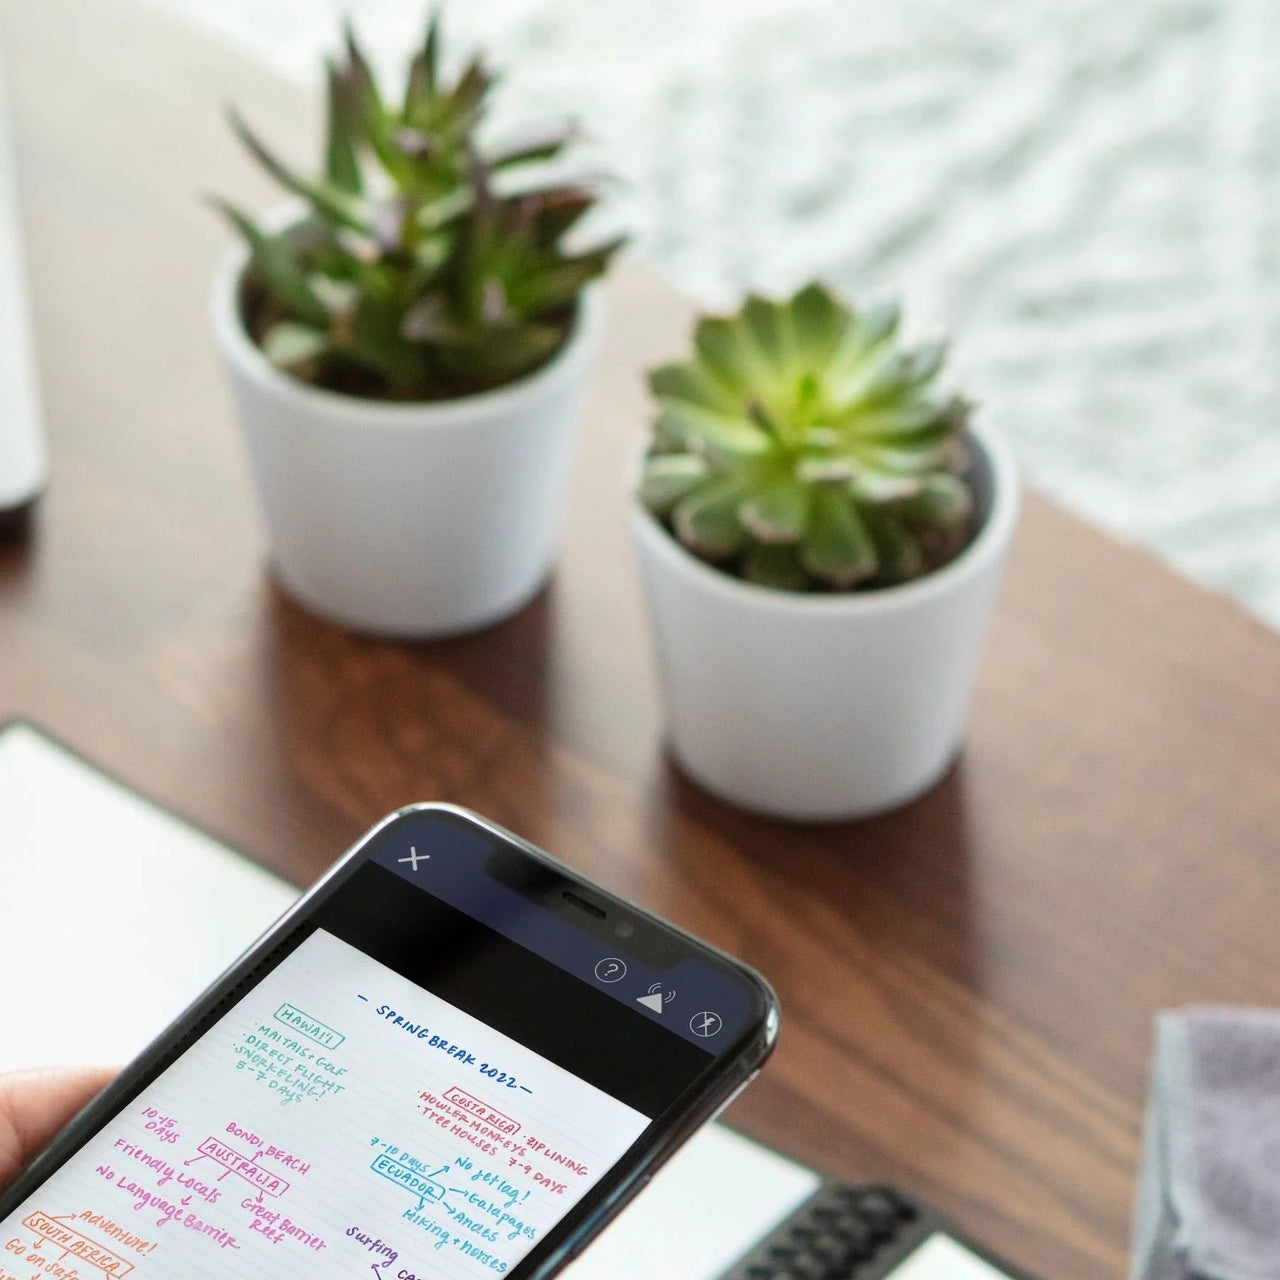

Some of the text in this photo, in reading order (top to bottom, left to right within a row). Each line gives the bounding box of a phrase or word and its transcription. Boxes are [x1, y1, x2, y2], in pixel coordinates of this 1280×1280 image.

[246, 1035, 345, 1095] DIRECT FLIGHT
[376, 1004, 517, 1088] SPRING BREAK 2022
[451, 1093, 515, 1134] COSTA RICA
[113, 1138, 173, 1187] Friendly
[205, 1142, 280, 1192] AUSTRALIA
[226, 1122, 311, 1176] BONDI BEACH
[454, 1156, 472, 1171] No
[95, 1165, 115, 1181] No
[116, 1176, 184, 1227] Language
[378, 1160, 437, 1200] ECUADOR
[532, 1172, 568, 1195] DAYS
[78, 1210, 158, 1256] Adventure!
[240, 1198, 327, 1253] Great Barrier
[248, 1219, 287, 1245] Reef
[453, 1211, 500, 1243] Andes
[468, 1193, 538, 1242] Galapagos
[4, 1238, 27, 1255] Go
[26, 1253, 46, 1268] on
[29, 1218, 120, 1272] SOUTH AFRICA
[346, 1226, 399, 1268] Surfing
